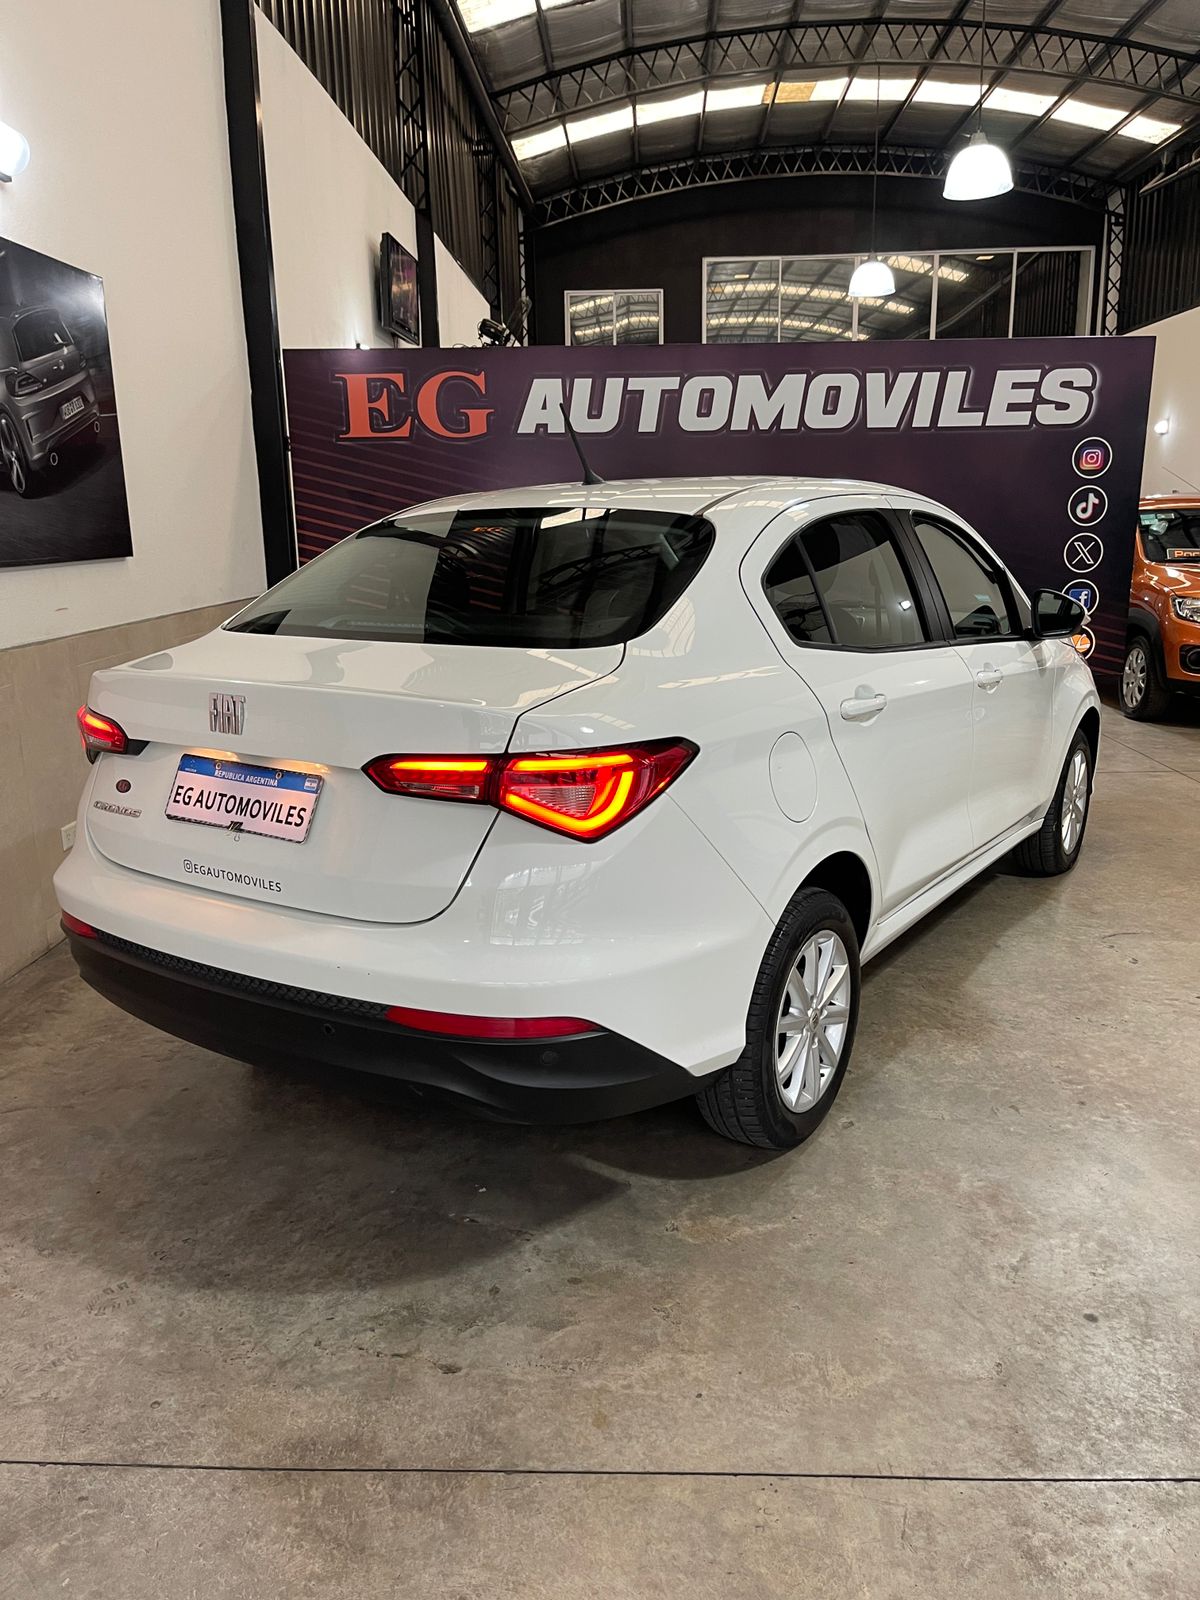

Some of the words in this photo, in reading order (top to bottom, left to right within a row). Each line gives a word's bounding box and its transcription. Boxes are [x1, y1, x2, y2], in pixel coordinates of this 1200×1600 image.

[335, 371, 495, 439] EG
[517, 368, 1093, 434] AUTOMOVILES
[208, 692, 246, 736] FIAT
[214, 769, 245, 782] REPUBLICA
[245, 775, 278, 787] ARGENTINA
[172, 785, 194, 806] EG
[193, 789, 307, 828] AUTOMOVILES
